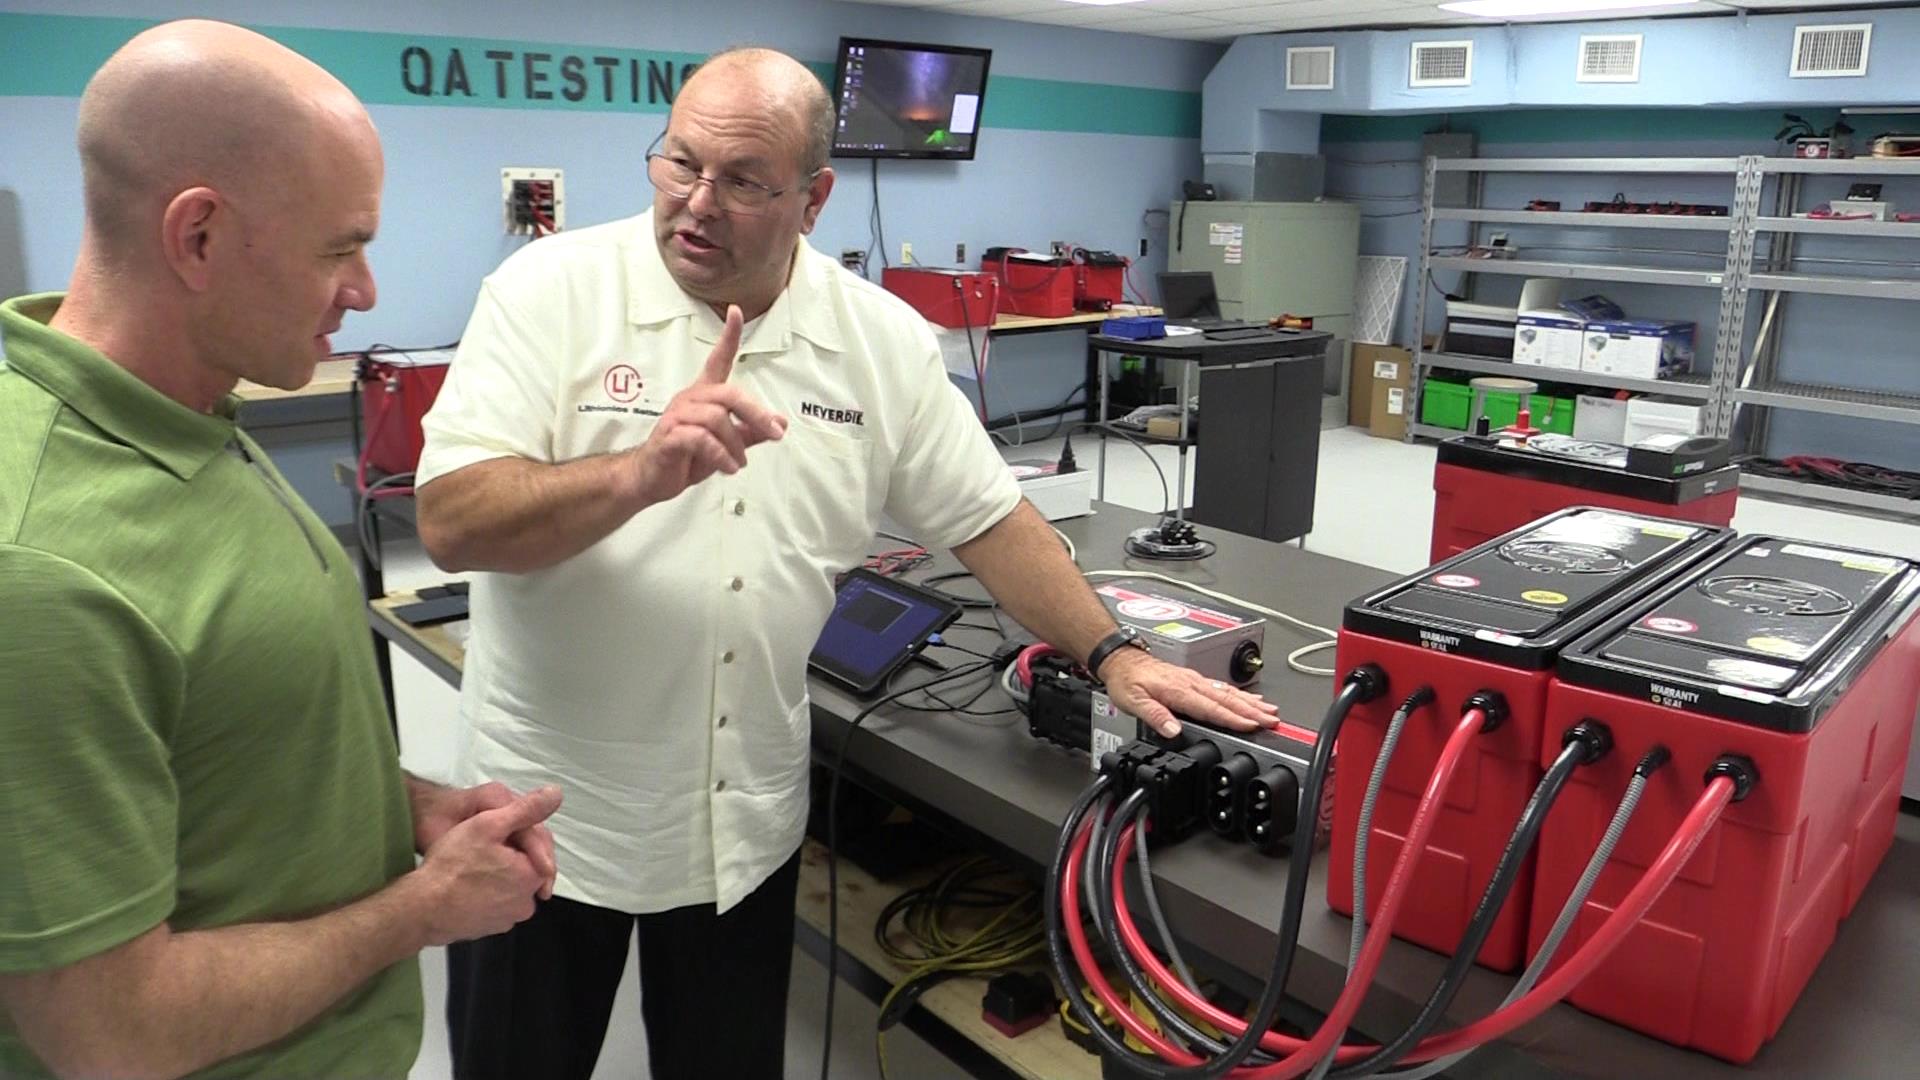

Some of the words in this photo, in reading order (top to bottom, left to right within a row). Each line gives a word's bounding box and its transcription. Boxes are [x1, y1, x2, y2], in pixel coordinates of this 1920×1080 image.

[801, 402, 864, 426] NEVERDIE
[1420, 630, 1461, 647] WARRANTY
[1650, 683, 1700, 704] WARRANTY
